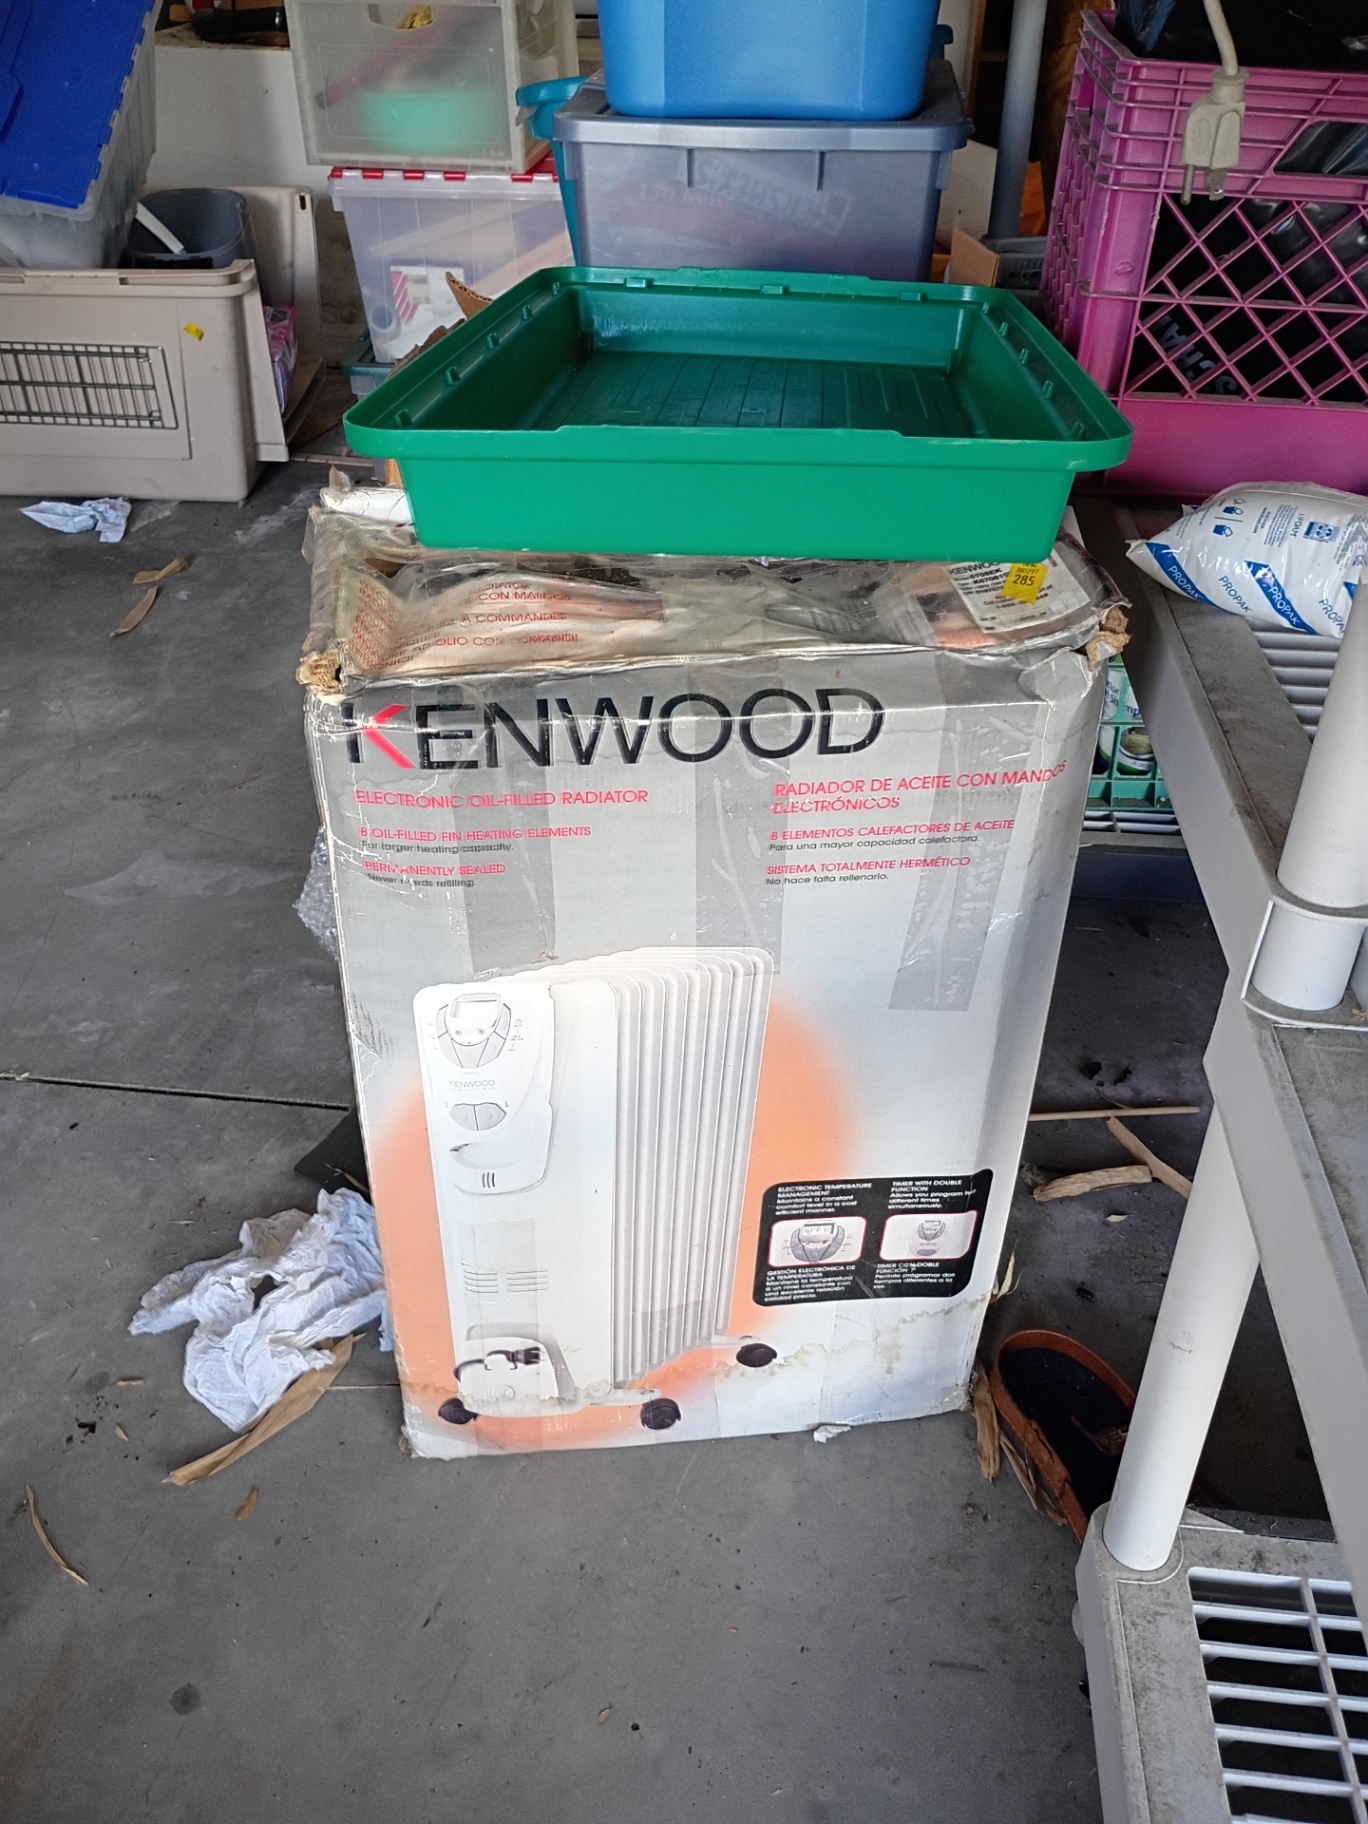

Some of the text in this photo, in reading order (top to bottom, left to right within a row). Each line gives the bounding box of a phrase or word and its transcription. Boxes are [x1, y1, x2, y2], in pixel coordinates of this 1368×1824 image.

[948, 562, 1000, 575] KENWO
[1013, 574, 1036, 586] 285
[1168, 565, 1203, 600] PROPAK
[477, 592, 509, 601] CON
[512, 591, 571, 602] MANDOS
[1218, 575, 1253, 613] PROPAK
[1268, 585, 1301, 626] PROPAK
[475, 612, 567, 623] COMMANDES
[1318, 598, 1345, 634] PROPA
[435, 637, 468, 646] OLIO
[342, 688, 885, 769] KENWOOD
[774, 760, 1067, 797] RADIADOR DE ACEITE CON MANDOS
[355, 789, 648, 808] ELECTRONIC OIL-FILLED RADIATOR
[772, 796, 900, 814] ELECTRÓNICOS
[359, 826, 591, 842] 8 OIL-FILLED FIN HEATING ELEMENTS
[770, 820, 1015, 841] 8 ELEMENTOS CALEFACTORES DE ACEITE
[361, 841, 378, 850] For
[380, 842, 414, 853] larger
[416, 843, 459, 854] heating
[770, 843, 793, 851] Para
[820, 841, 854, 850] mayor
[857, 837, 916, 848] capacidad
[363, 861, 506, 876] PERMANENTLY SEALED
[767, 855, 971, 875] SISTEMA TOTALMENTE HERMÉTICO
[366, 873, 397, 884] Never
[437, 879, 476, 888] refilling.
[784, 876, 811, 884] hace
[814, 875, 836, 883] falta
[839, 872, 889, 882] rellenarlo.
[450, 1079, 496, 1088] KENWOOD
[778, 1185, 822, 1193] ELECTRONIC
